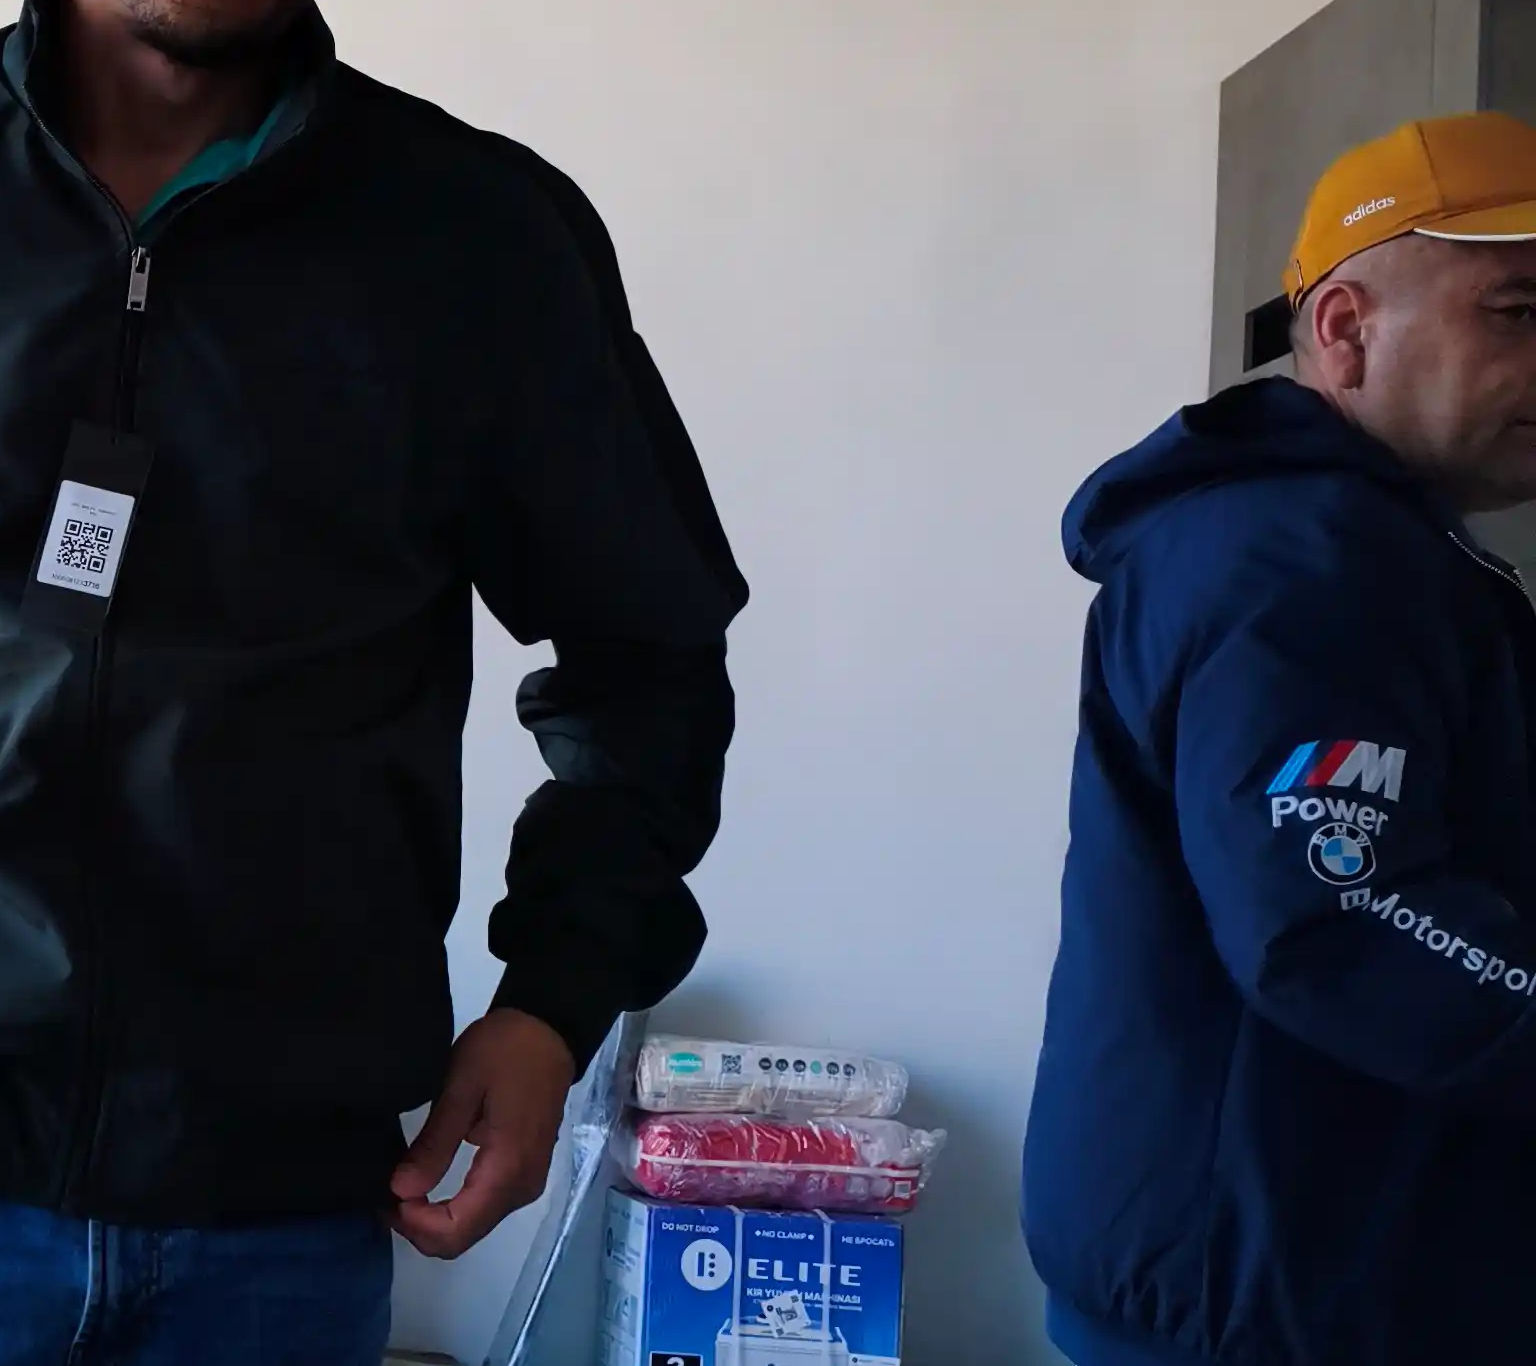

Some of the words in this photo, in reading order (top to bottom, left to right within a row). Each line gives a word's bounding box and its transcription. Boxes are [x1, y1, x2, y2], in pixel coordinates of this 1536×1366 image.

[1343, 196, 1396, 227] adidas
[1271, 795, 1389, 836] Power
[661, 1221, 675, 1232] DO
[675, 1223, 694, 1233] NOT
[695, 1224, 720, 1235] DROP
[747, 1257, 863, 1287] ELITE
[747, 1287, 763, 1298] KIR
